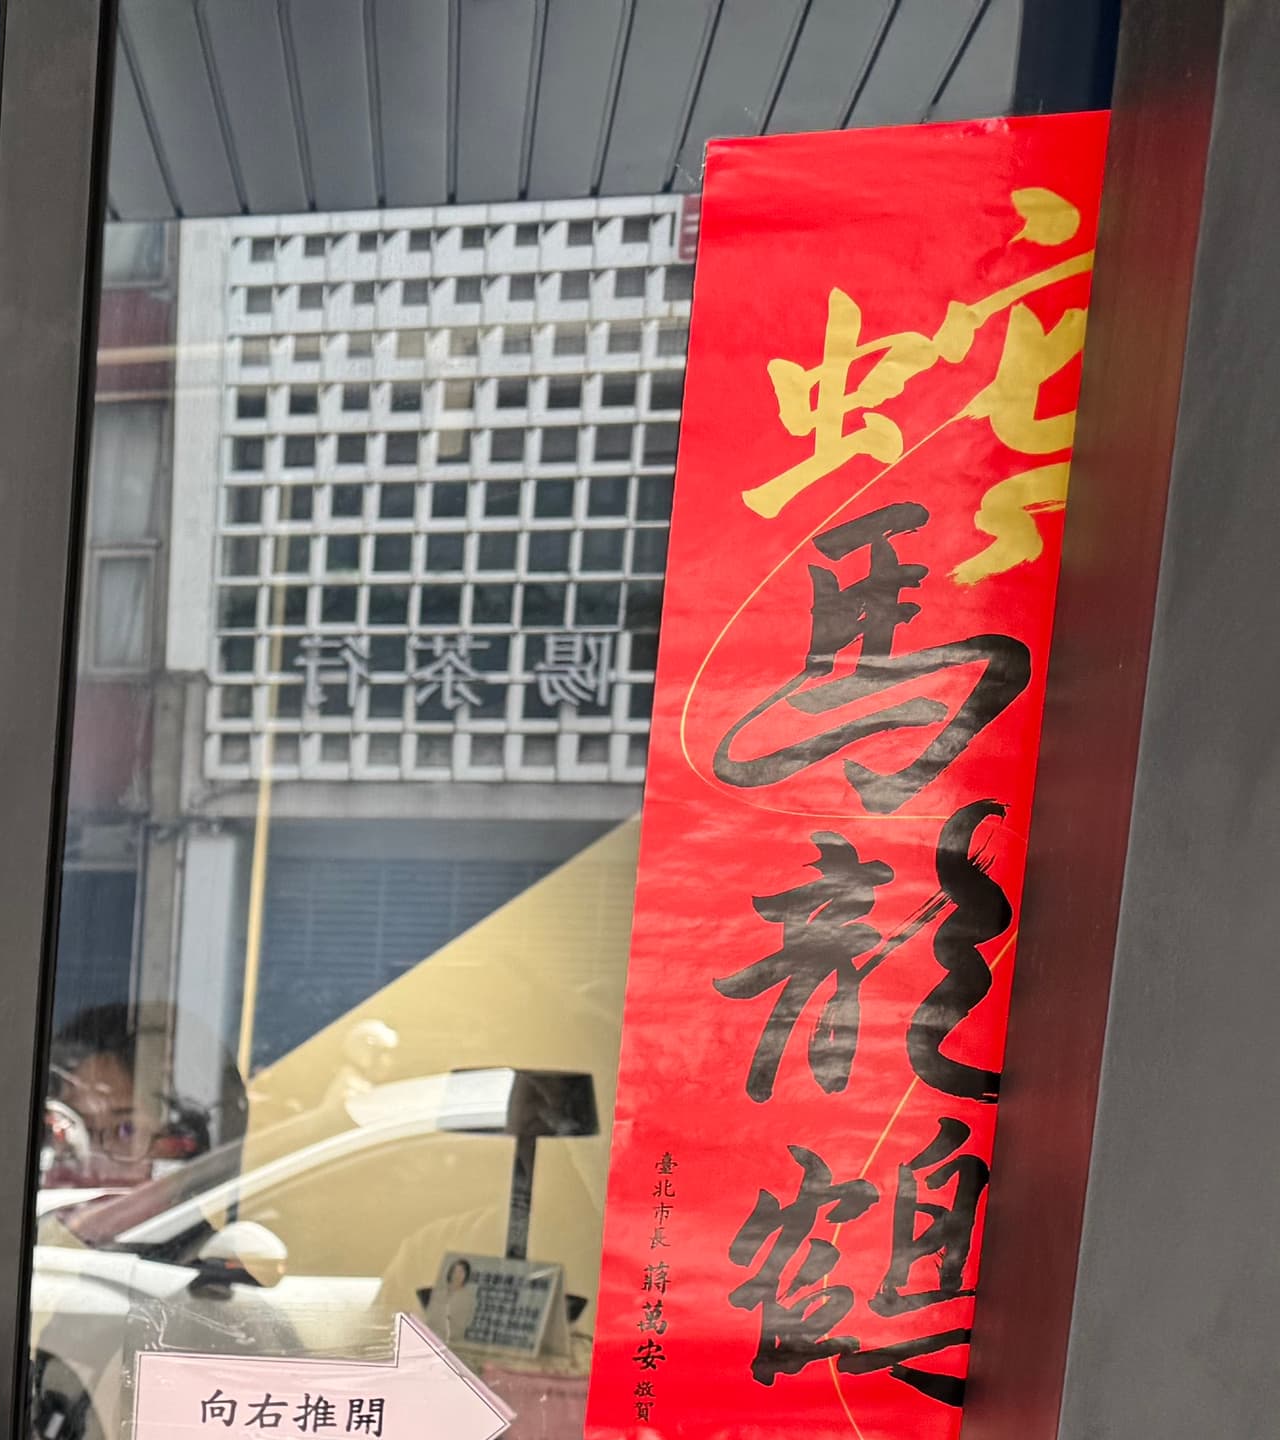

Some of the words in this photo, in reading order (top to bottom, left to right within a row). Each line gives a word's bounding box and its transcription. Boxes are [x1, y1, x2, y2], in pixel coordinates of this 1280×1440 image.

[650, 1152, 678, 1249] 臺北市長
[632, 1261, 670, 1370] 蔣萬安
[201, 1389, 385, 1438] 向右推開
[634, 1381, 656, 1422] 敬賀
